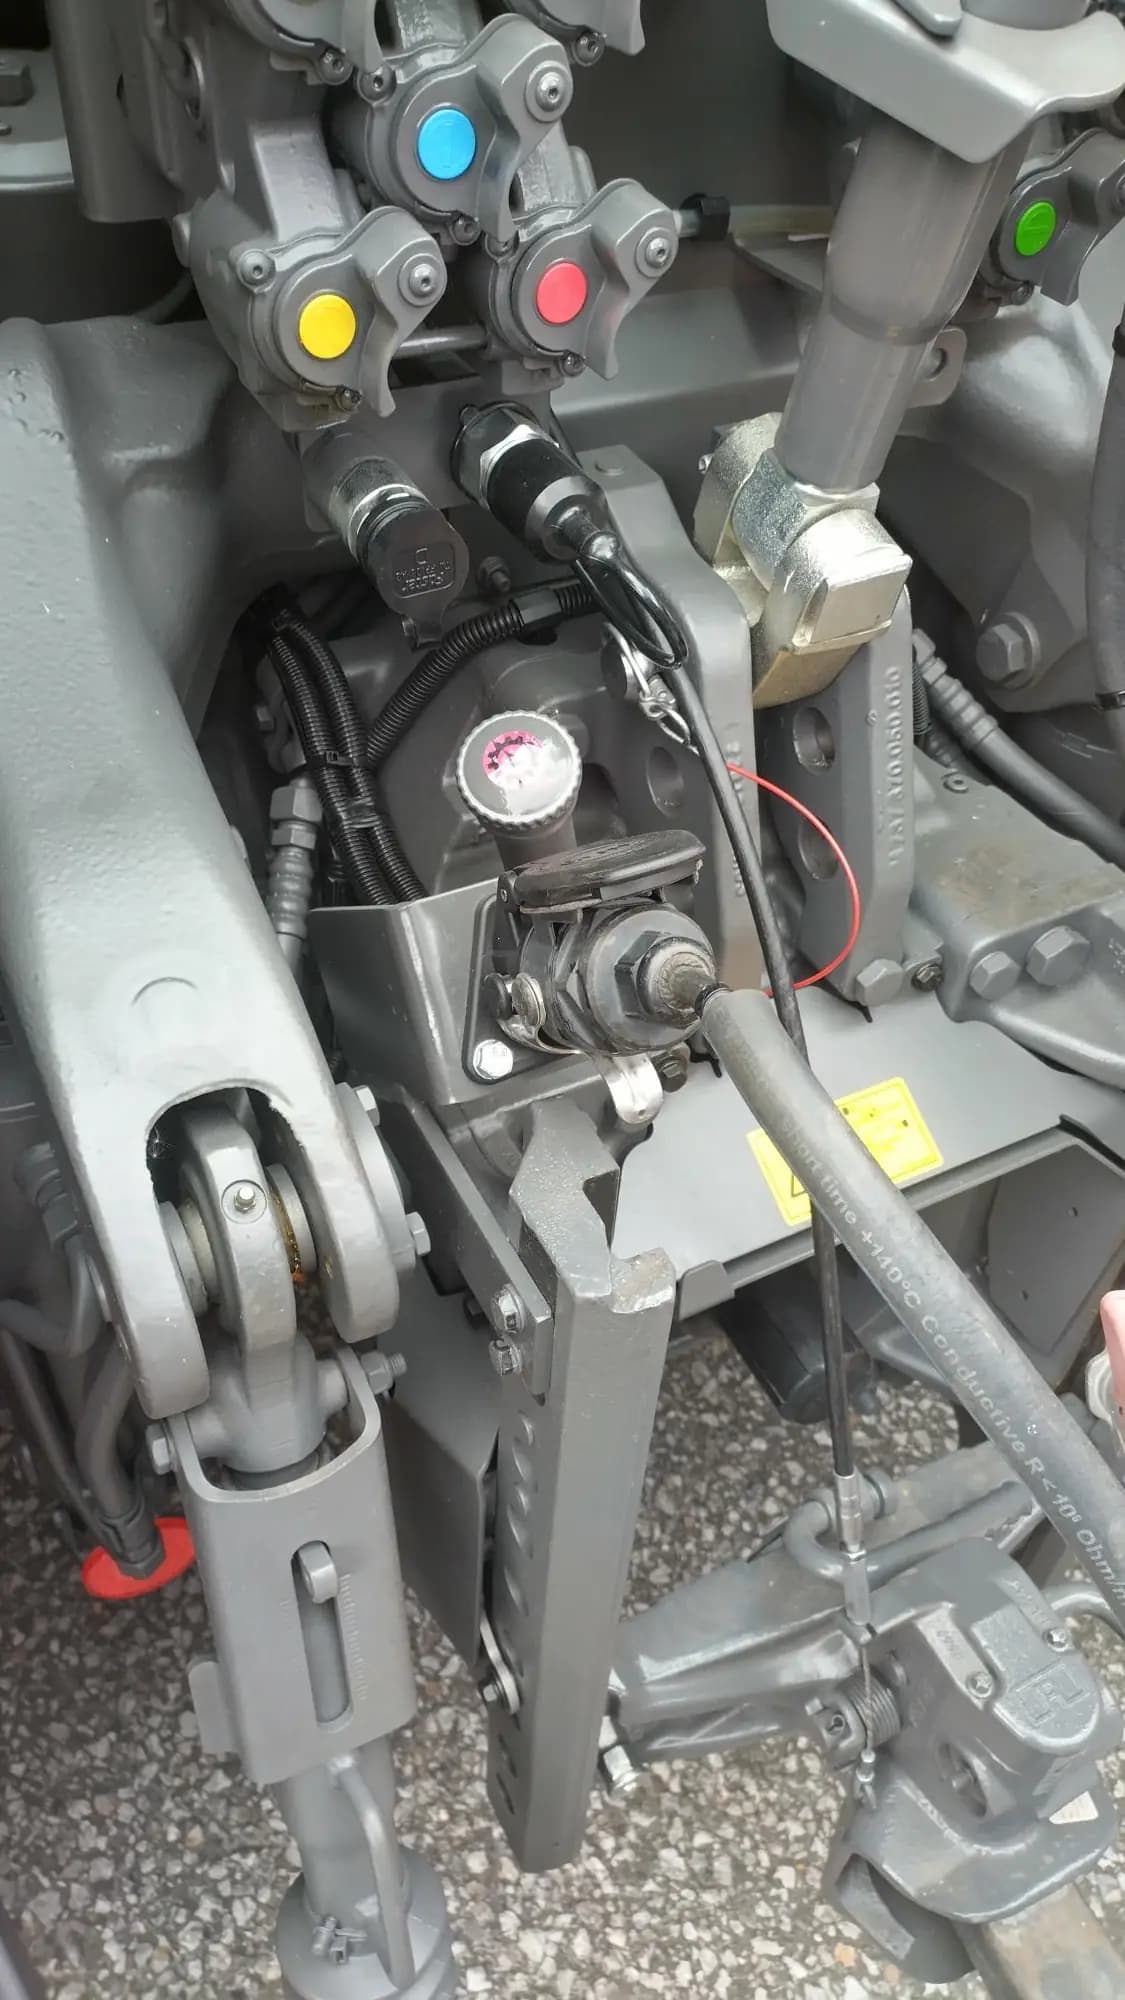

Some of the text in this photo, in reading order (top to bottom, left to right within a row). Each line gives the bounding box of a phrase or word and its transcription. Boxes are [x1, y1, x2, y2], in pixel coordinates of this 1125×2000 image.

[783, 1117, 823, 1174] short
[820, 1174, 857, 1225] time
[861, 1229, 921, 1309] +140°C
[920, 1314, 1026, 1454] Conductive
[1024, 1456, 1045, 1475] R
[1042, 1477, 1057, 1491] <
